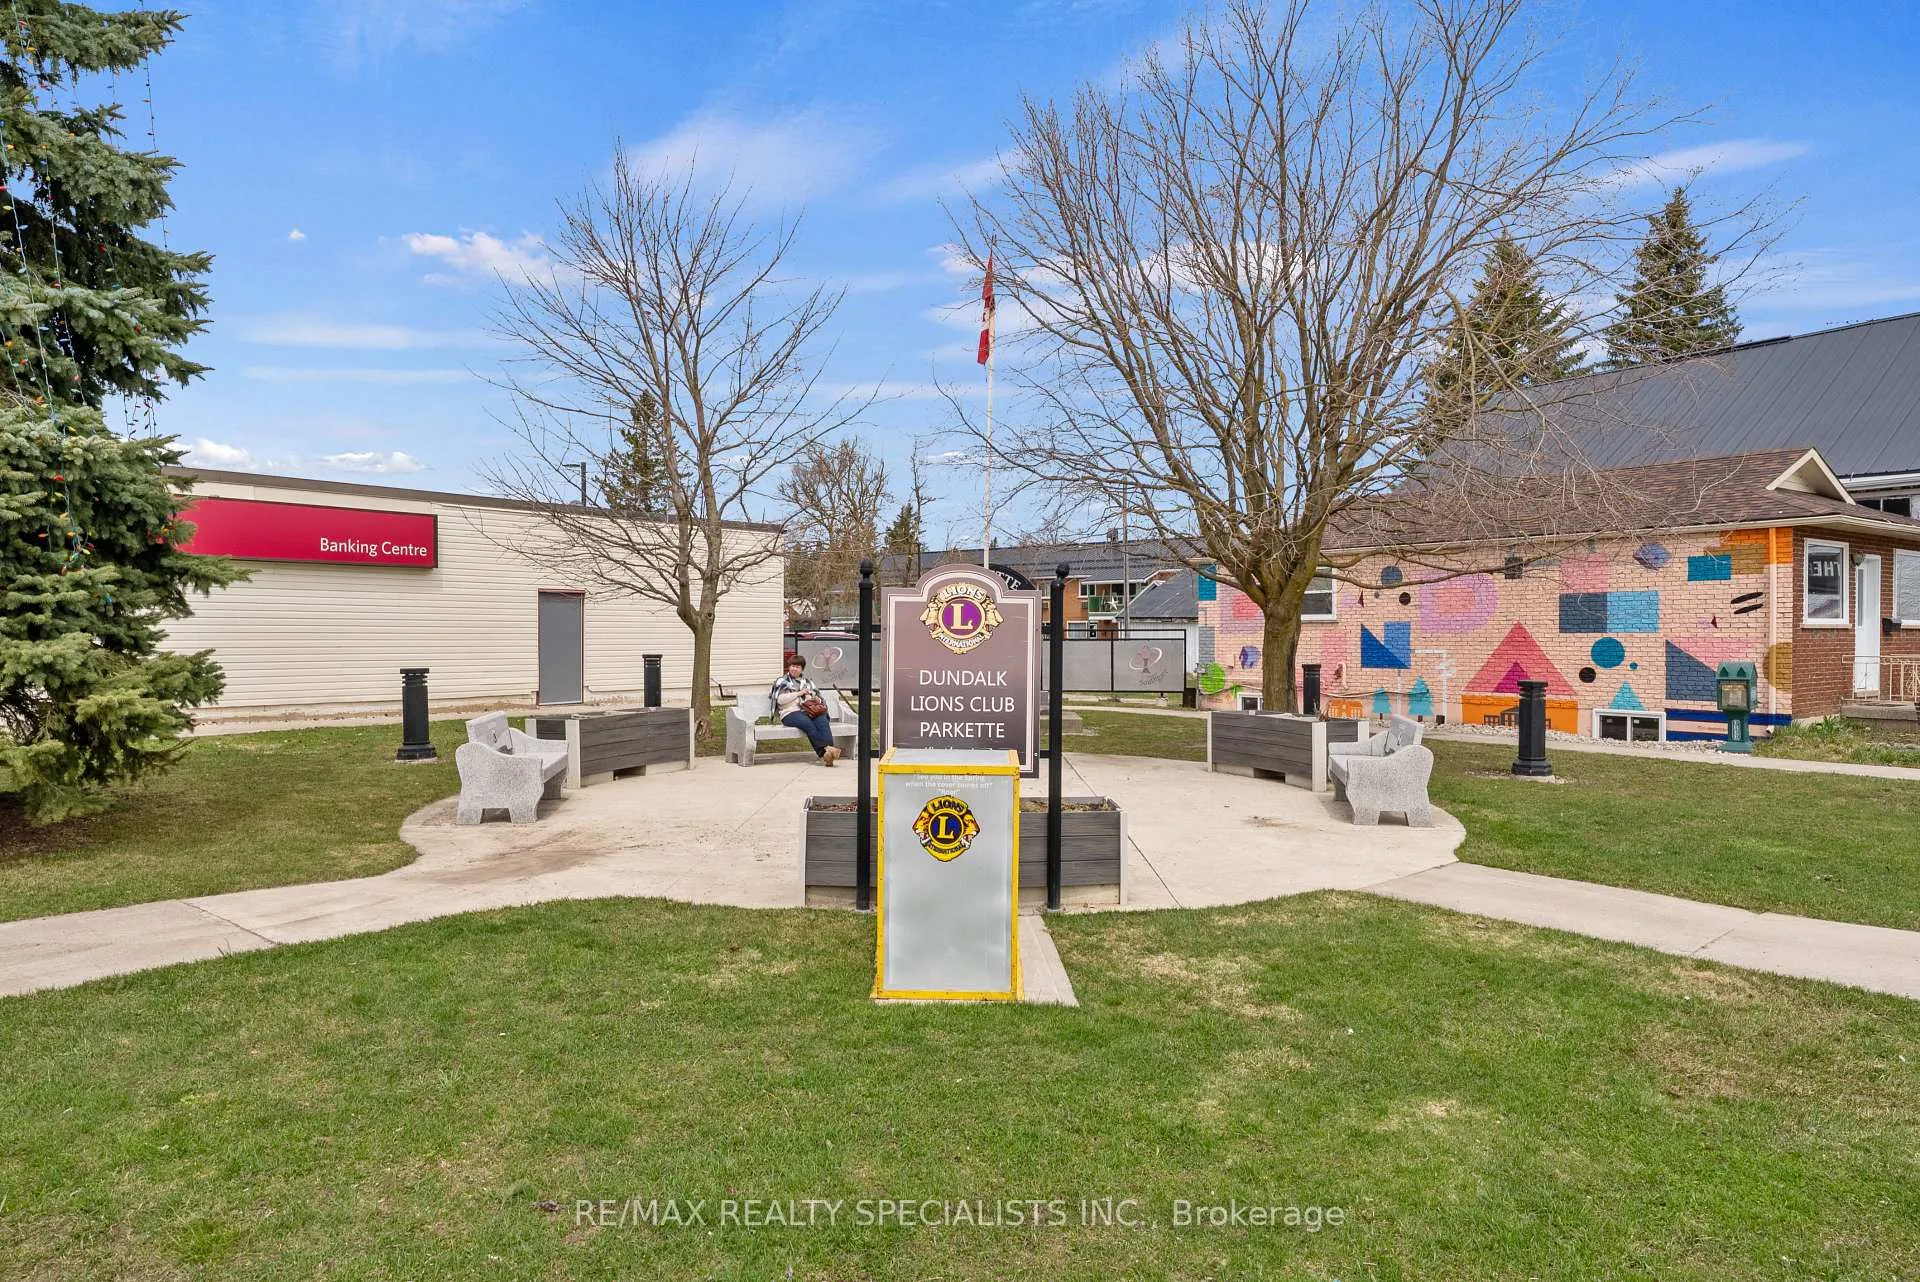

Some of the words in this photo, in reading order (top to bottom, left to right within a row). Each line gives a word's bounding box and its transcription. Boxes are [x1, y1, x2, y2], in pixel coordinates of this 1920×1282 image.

[320, 537, 378, 557] Banking
[381, 541, 428, 556] Centre
[941, 586, 985, 600] LIONS
[951, 603, 974, 630] L
[919, 669, 1008, 687] DUNDALK
[910, 695, 965, 713] LIONS
[969, 696, 1016, 713] CLUB
[919, 721, 1006, 739] PARKETTE
[931, 799, 965, 812] LIONS
[936, 815, 955, 840] L
